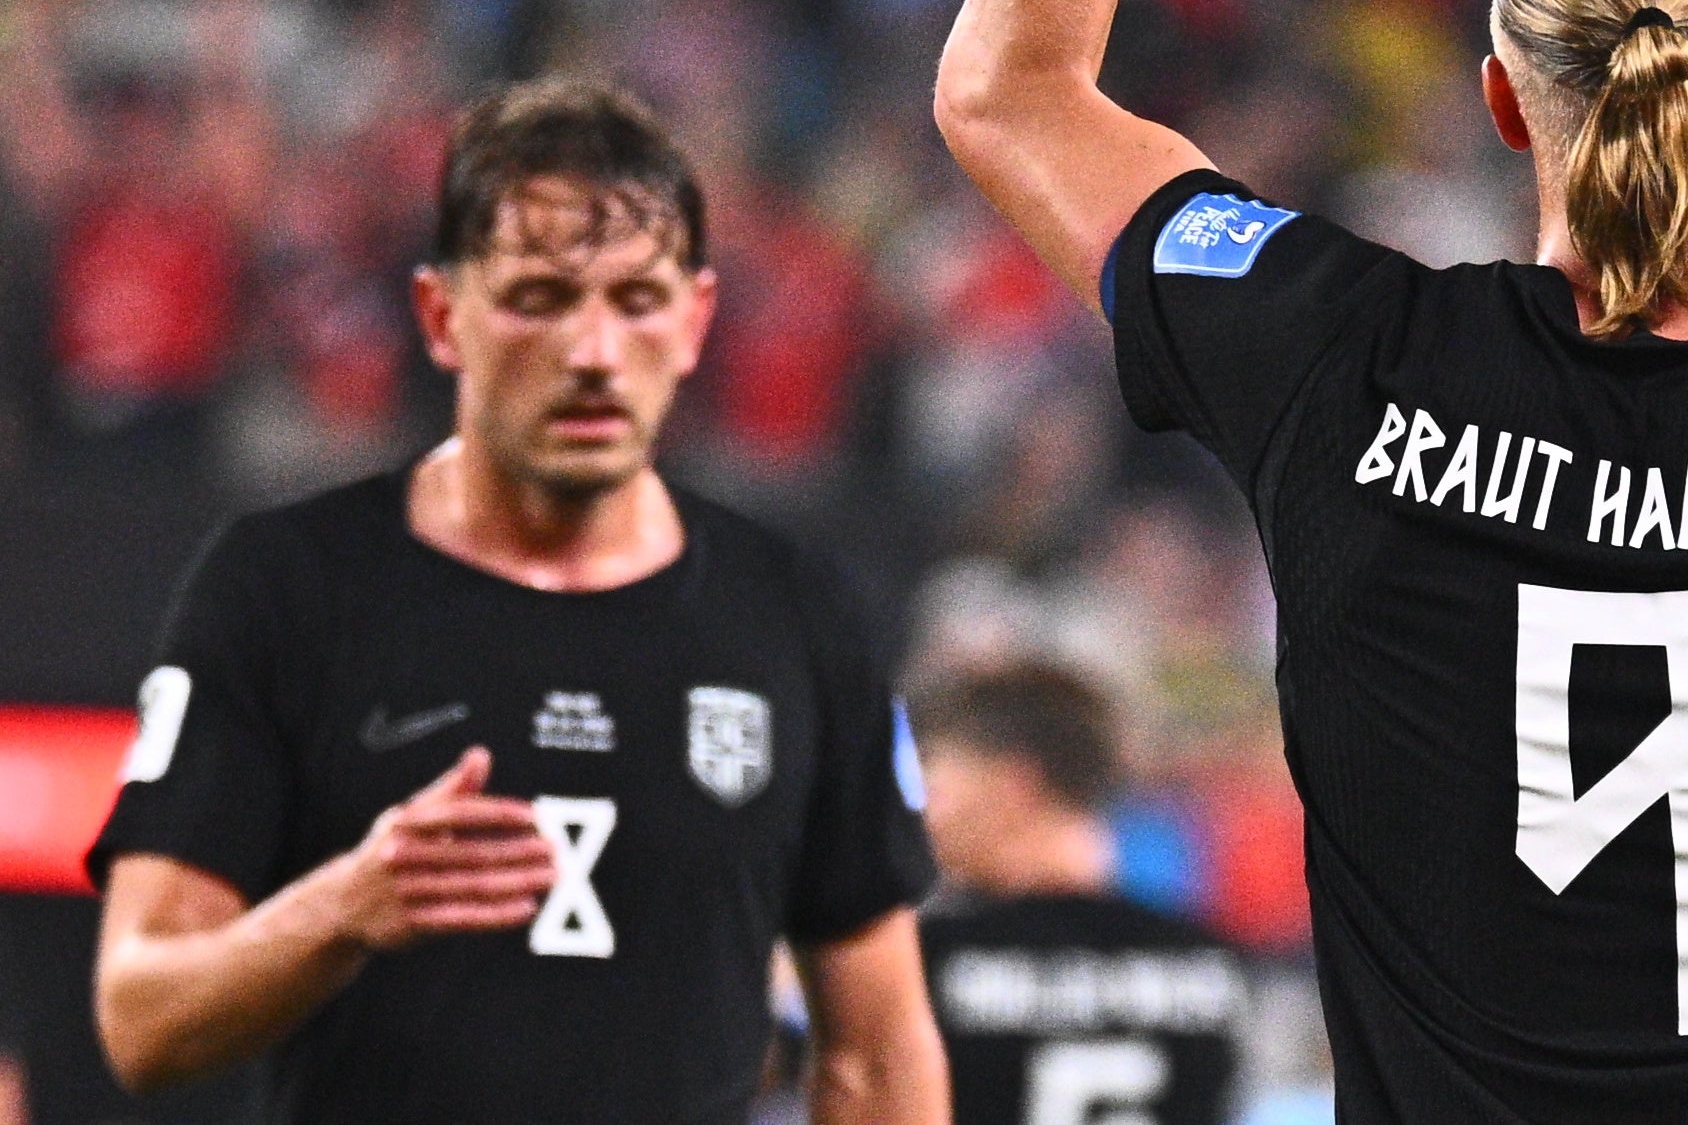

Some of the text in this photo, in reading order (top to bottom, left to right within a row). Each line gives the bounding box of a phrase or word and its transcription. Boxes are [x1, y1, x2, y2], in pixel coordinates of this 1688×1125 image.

[1179, 205, 1221, 246] PEACE
[1355, 402, 1574, 530] BRAUT
[529, 795, 618, 959] 8
